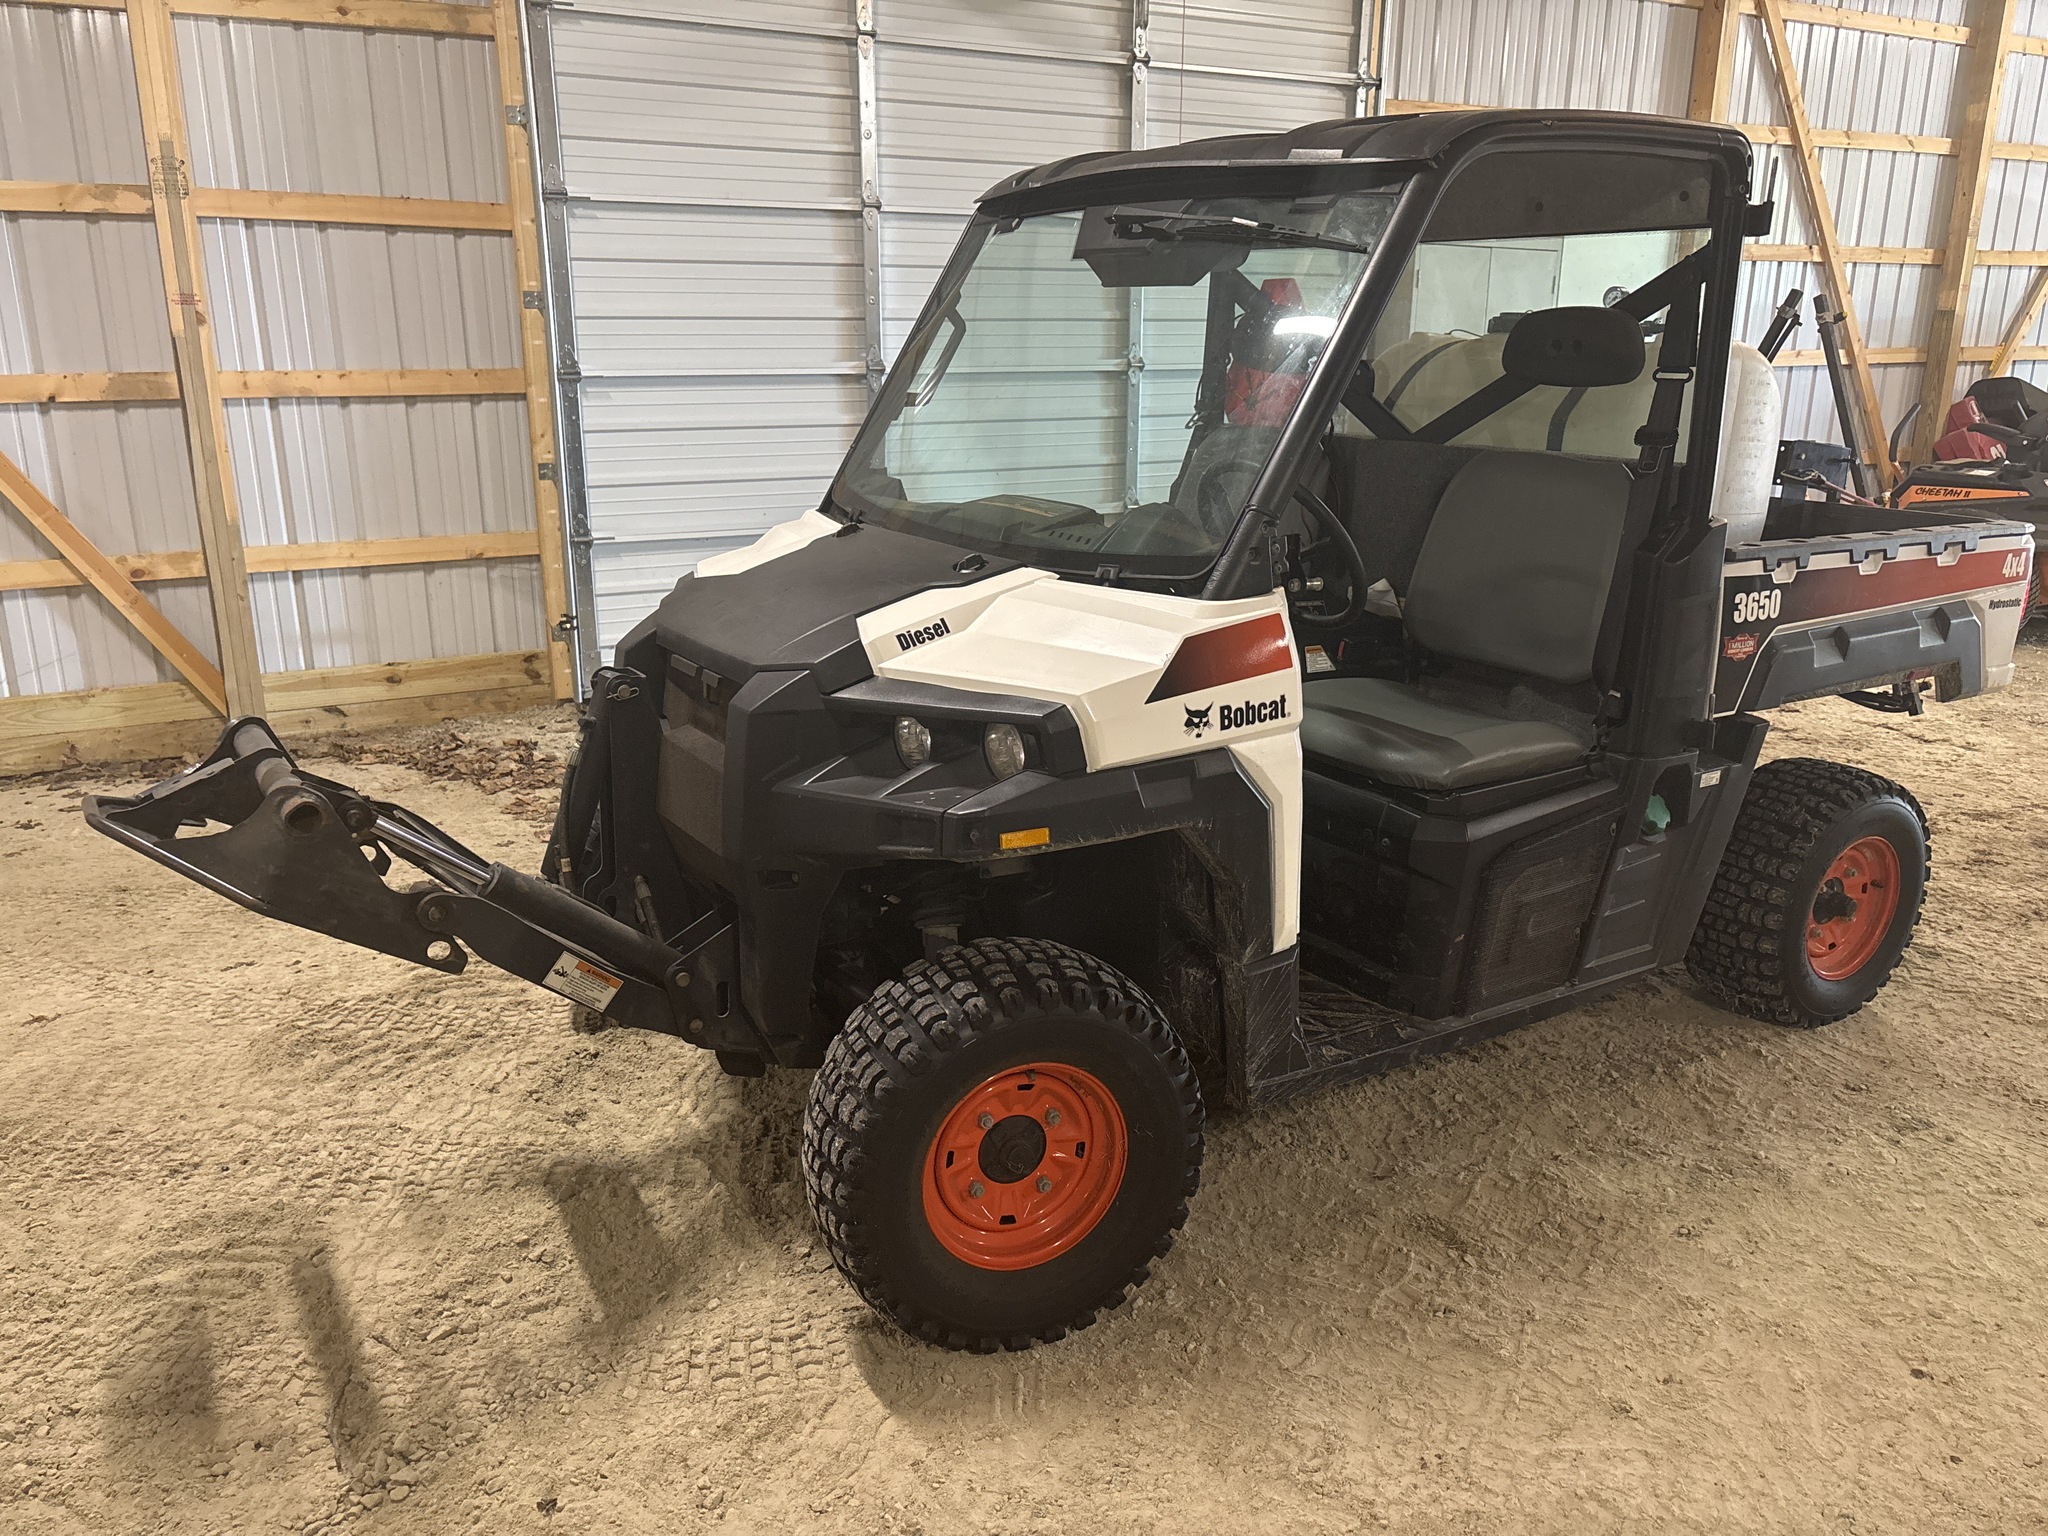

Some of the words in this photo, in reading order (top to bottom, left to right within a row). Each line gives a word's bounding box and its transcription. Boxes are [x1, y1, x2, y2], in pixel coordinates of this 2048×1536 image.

[1915, 487, 1962, 498] CHEETAH
[1963, 490, 1972, 498] II
[2002, 551, 2027, 578] 4x4
[1733, 588, 1782, 624] 3650
[1988, 598, 2022, 610] Hydrostatic
[895, 617, 951, 652] Diesel
[1731, 640, 1755, 649] MILLION
[1219, 693, 1287, 731] Bobcat
[591, 969, 611, 982] WARNING
